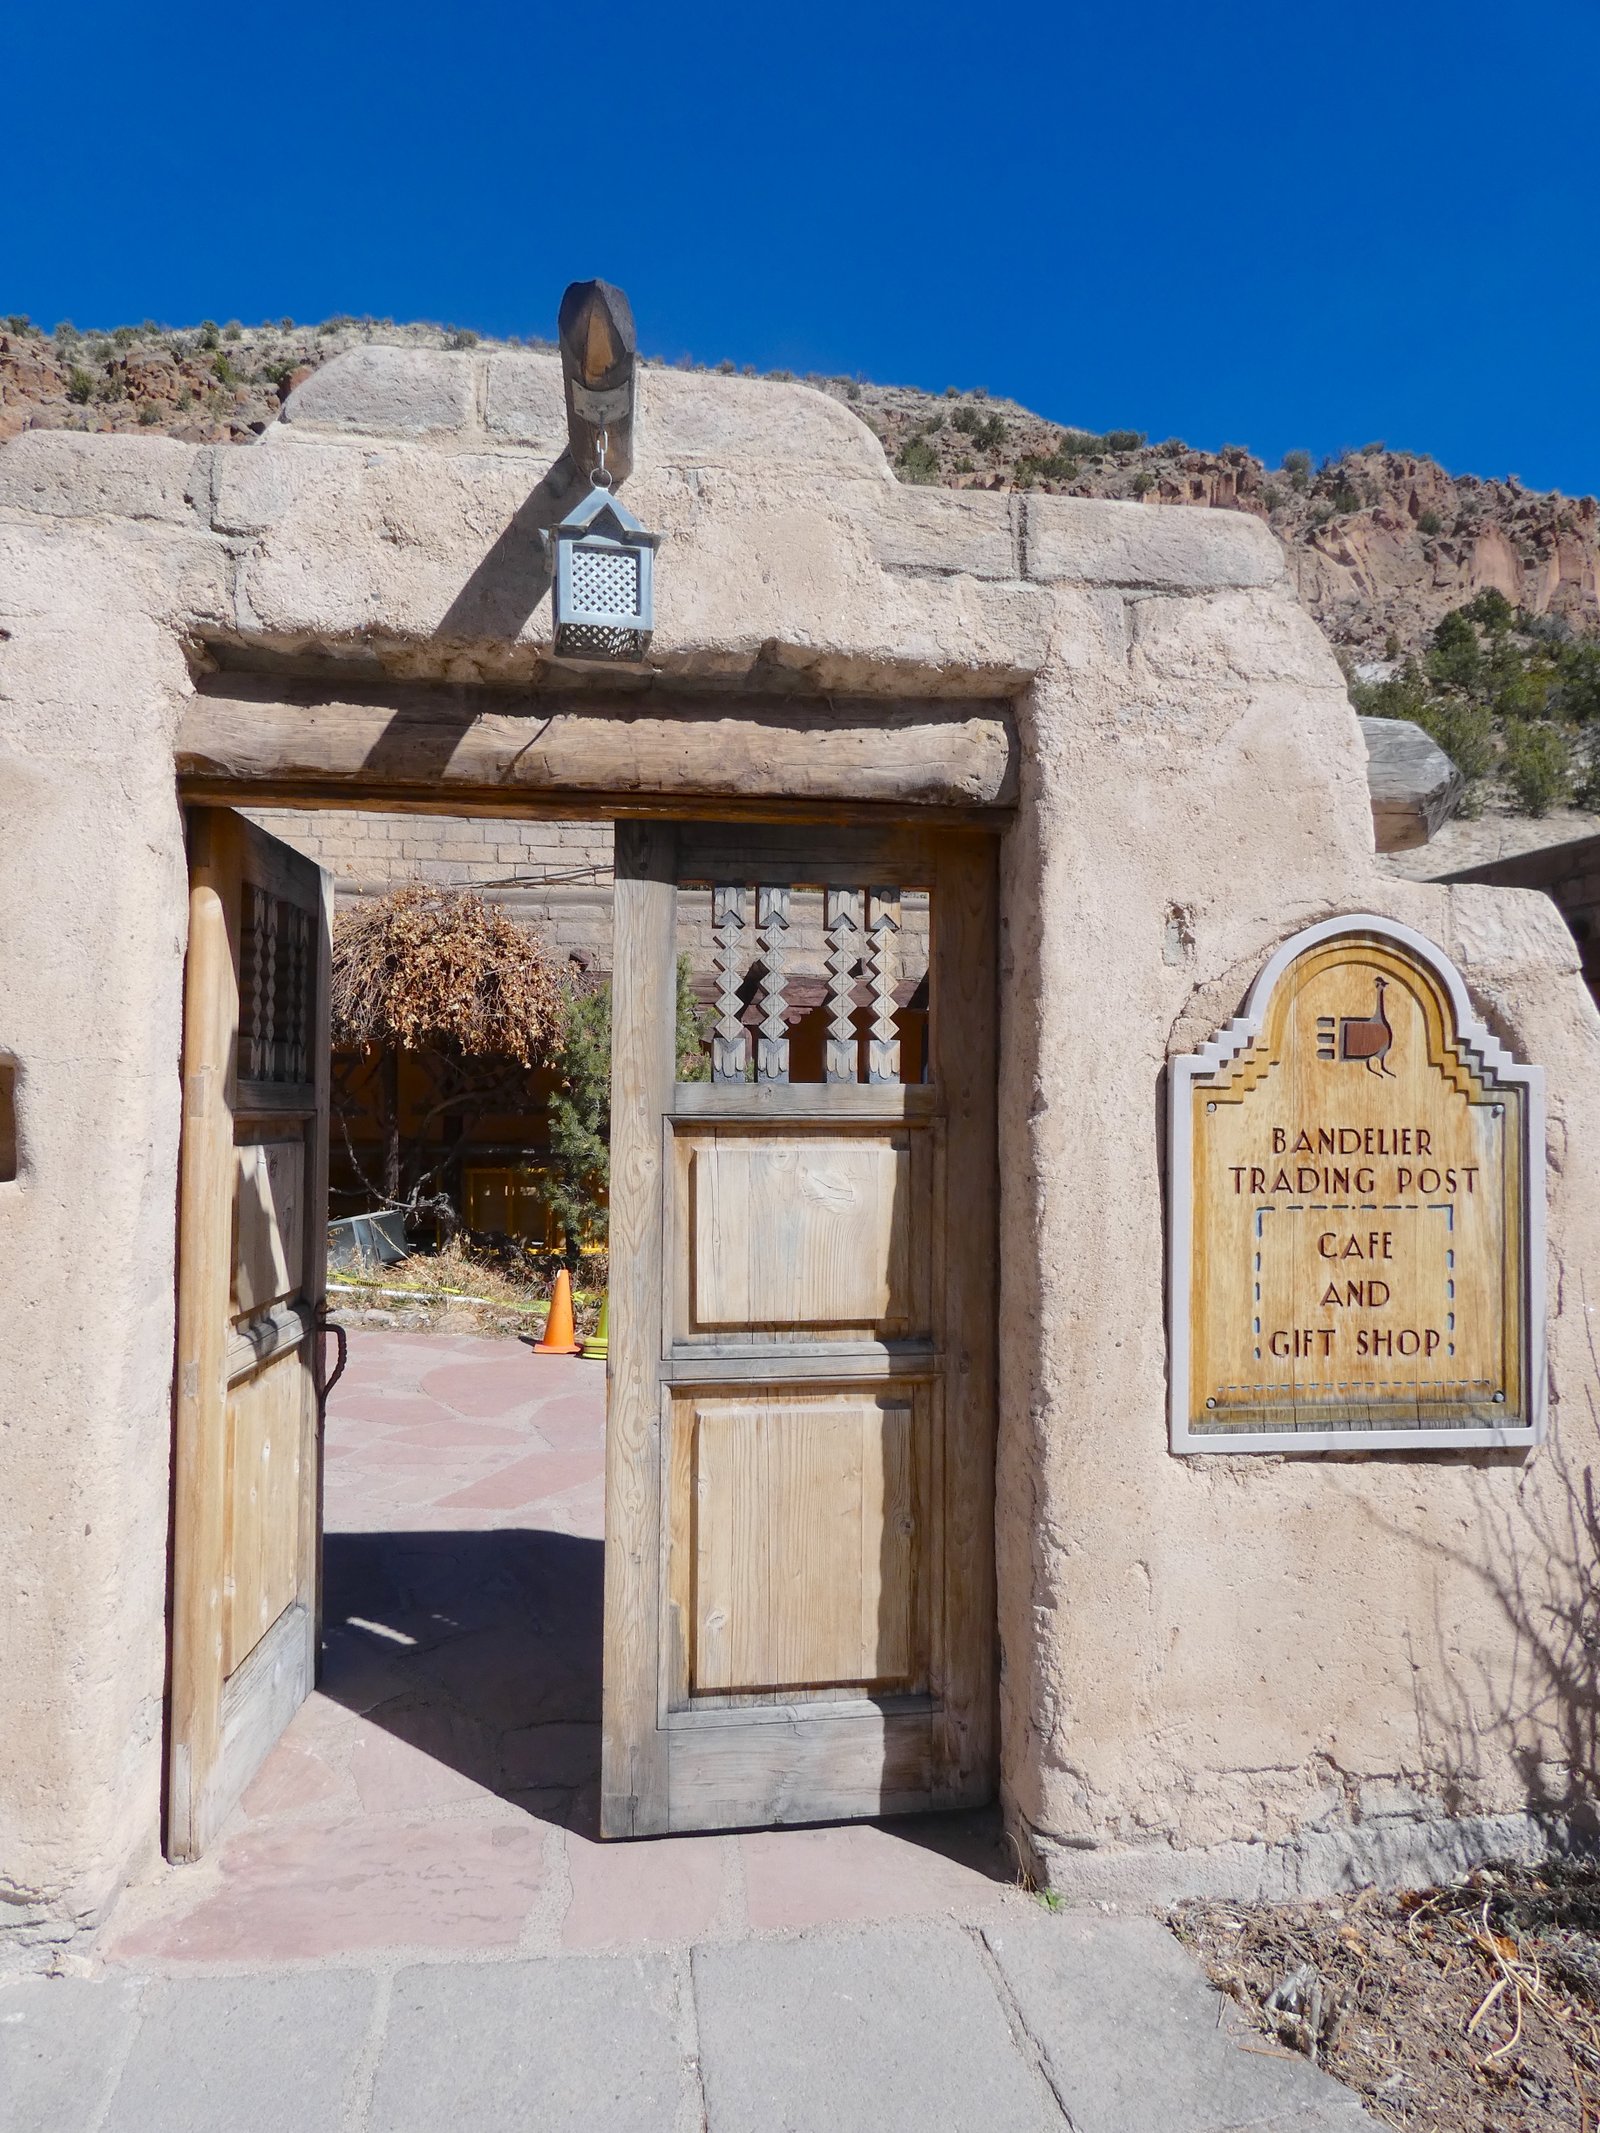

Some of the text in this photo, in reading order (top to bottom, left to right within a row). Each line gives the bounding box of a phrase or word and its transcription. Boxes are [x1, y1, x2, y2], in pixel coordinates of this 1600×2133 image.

[1272, 1127, 1432, 1155] BANDELIER
[1228, 1166, 1480, 1194] TRADING POST
[1317, 1231, 1393, 1260] CAFE
[1319, 1280, 1391, 1307] AND
[1268, 1329, 1441, 1358] GIFT SHOP
